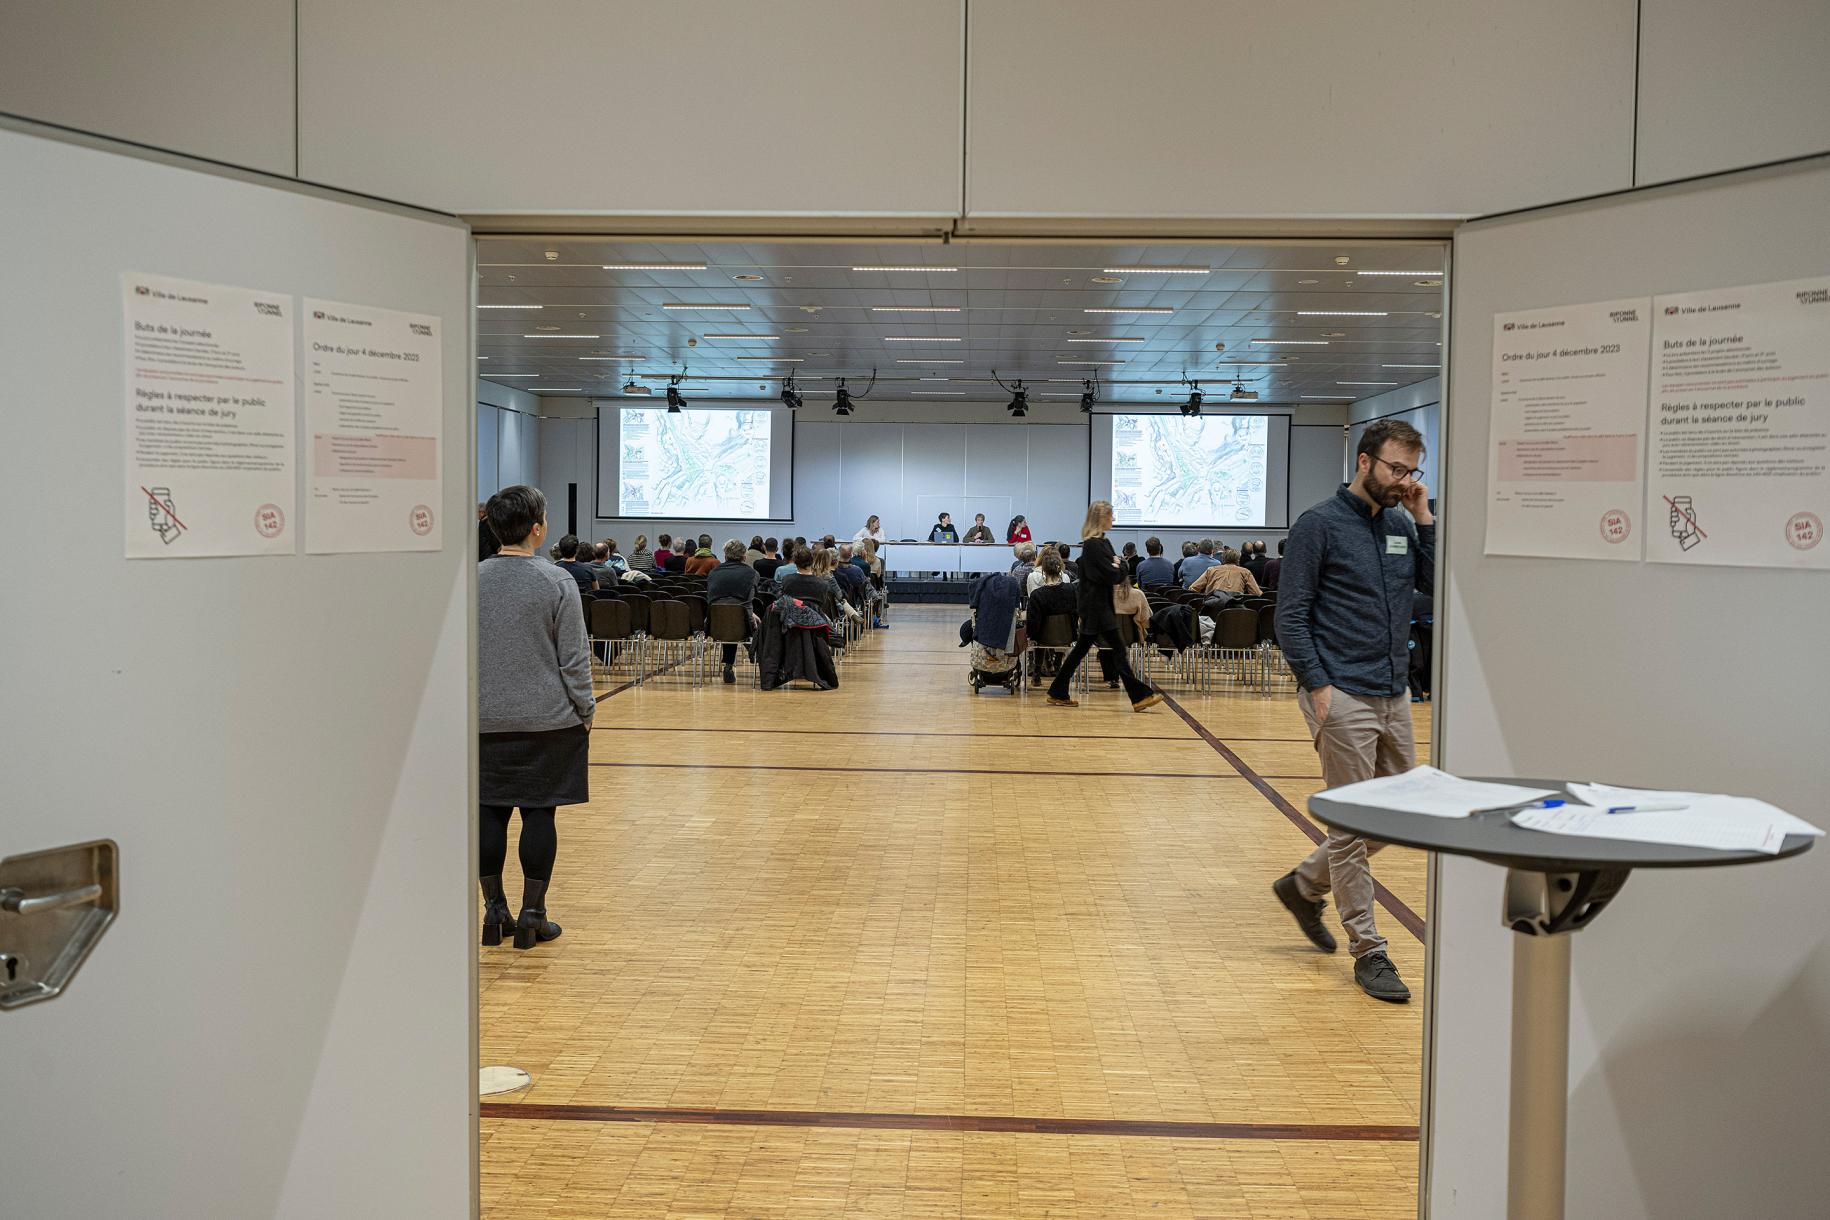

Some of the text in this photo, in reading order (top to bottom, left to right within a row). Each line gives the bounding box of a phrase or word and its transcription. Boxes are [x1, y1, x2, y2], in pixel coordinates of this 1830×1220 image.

[152, 291, 166, 299] Ville
[178, 293, 208, 304] Lausanne
[1681, 302, 1741, 314] Ville de Lausanne
[326, 314, 338, 322] Ville
[348, 317, 372, 326] Lausanne
[1538, 320, 1565, 329] Lausanne
[135, 320, 212, 339] Buts de la journée
[1664, 333, 1744, 349] Buts de la journée
[313, 342, 334, 353] Ordre
[336, 346, 346, 354] du
[346, 347, 360, 357] jour
[362, 348, 367, 356] 4
[368, 349, 402, 360] décembre
[1502, 350, 1524, 362] Ordre
[1525, 350, 1535, 360] du
[1536, 351, 1550, 364] jour
[1560, 346, 1598, 358] décembre
[1600, 344, 1621, 354] 2023
[136, 388, 266, 408] Règles à respecter par le public
[136, 403, 236, 419] durant la séance de jury
[1661, 396, 1806, 414] Règles à respecter par le public
[1660, 412, 1769, 426] durant la séance de jury
[262, 512, 276, 521] SIA
[416, 512, 427, 520] SIA
[1607, 517, 1622, 527] SIA
[264, 521, 277, 530] 142
[1609, 526, 1623, 535] 142
[1794, 520, 1812, 531] SIA
[1796, 531, 1814, 541] 142
